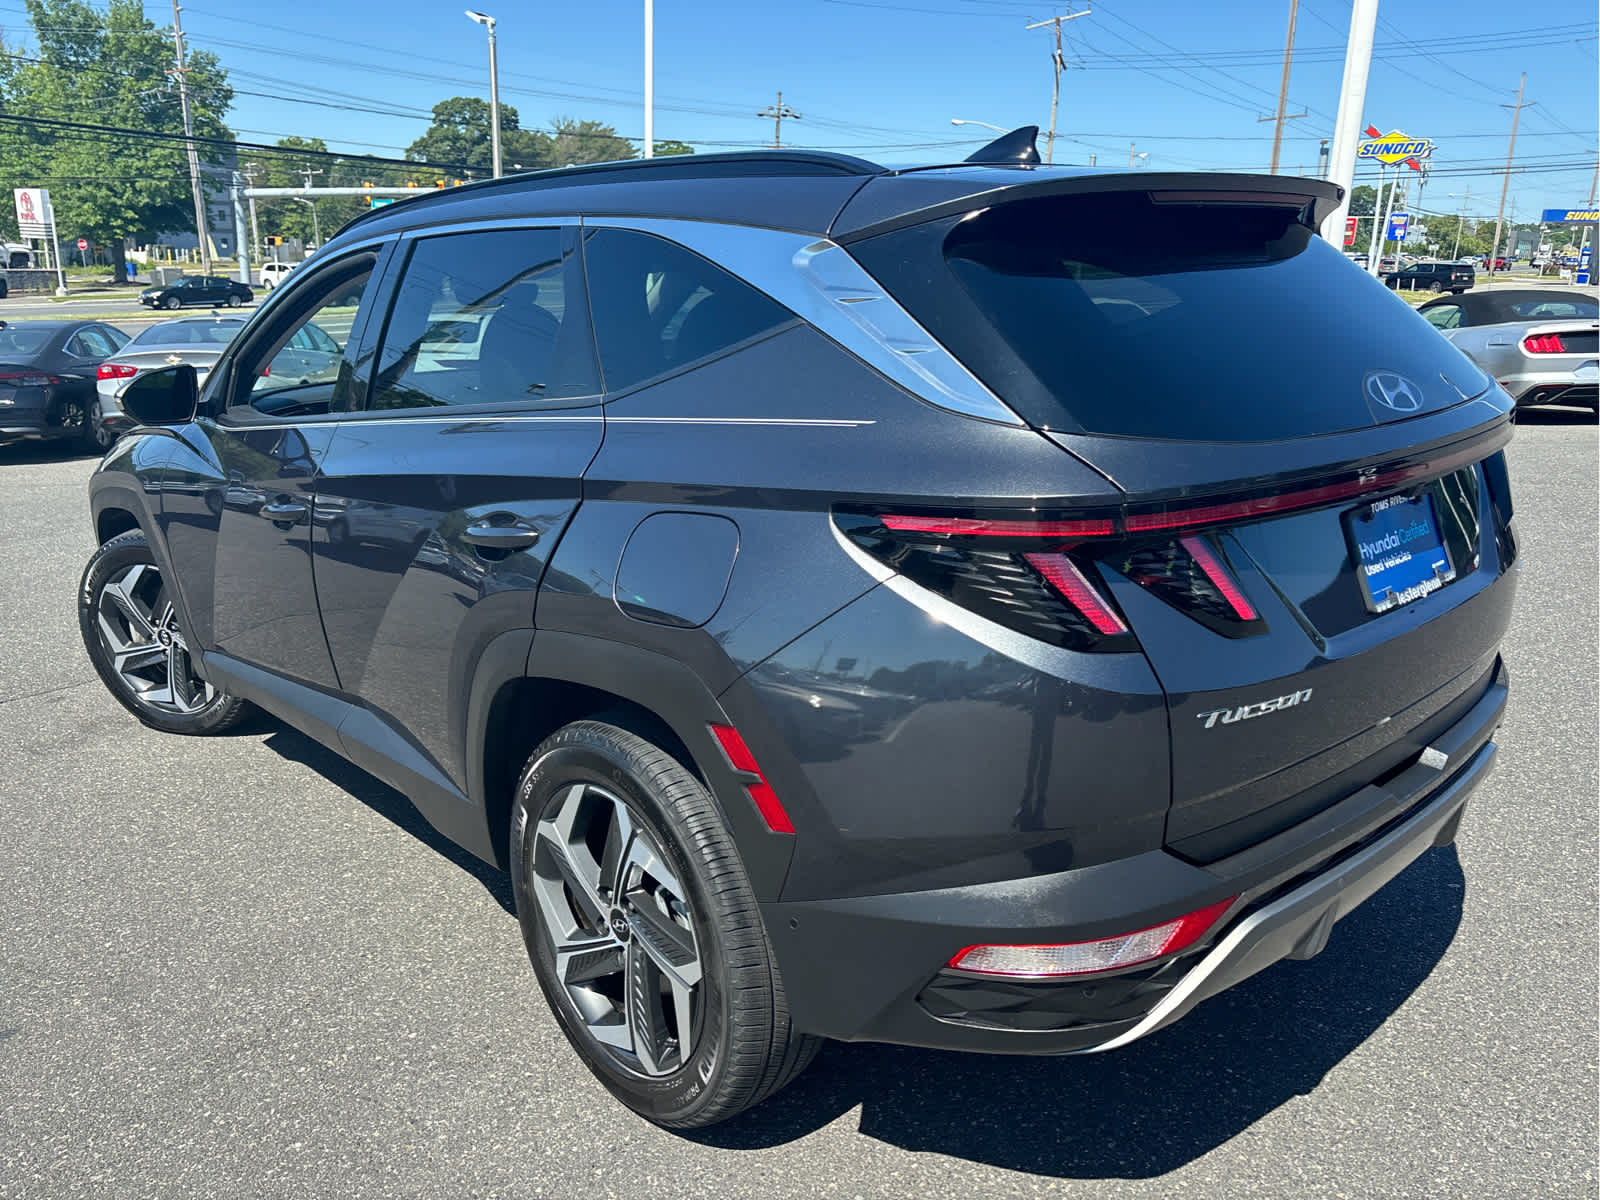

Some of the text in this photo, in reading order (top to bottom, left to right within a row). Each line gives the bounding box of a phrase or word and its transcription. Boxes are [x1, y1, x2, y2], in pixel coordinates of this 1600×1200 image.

[1360, 142, 1426, 155] SUNOCO
[1371, 499, 1389, 512] TOMS
[1364, 551, 1412, 576] Used Vehicles
